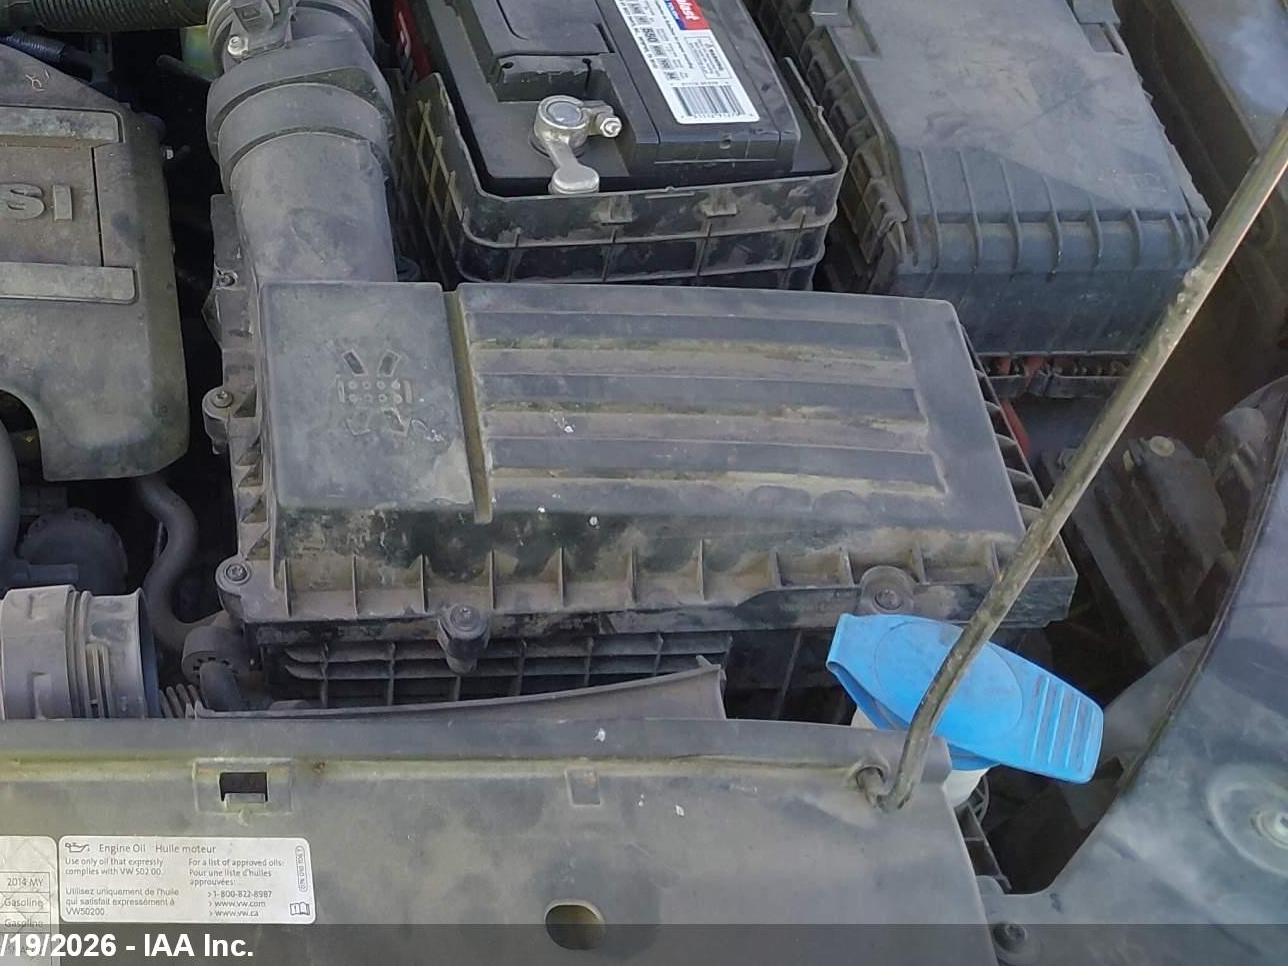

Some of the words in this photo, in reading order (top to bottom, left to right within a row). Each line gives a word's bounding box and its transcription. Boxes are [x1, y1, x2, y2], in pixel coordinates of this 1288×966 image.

[99, 843, 130, 855] Engine
[132, 843, 146, 853] Oil
[182, 845, 217, 853] moteur
[81, 858, 97, 867] only
[99, 857, 108, 865] oil
[111, 857, 126, 865] that
[128, 858, 163, 867] expressly
[188, 858, 201, 866] For
[208, 858, 220, 866] list
[222, 858, 230, 866] of
[232, 858, 267, 868] approved
[65, 868, 99, 877] complies
[189, 868, 207, 877] Pour
[224, 868, 240, 877] liste
[7, 877, 27, 886] 2014
[29, 878, 43, 886] MY
[96, 888, 142, 897] uniquement
[4, 898, 43, 907] Gasoline
[65, 898, 77, 906] qui
[80, 897, 110, 905] satisfait
[4, 919, 43, 928] Gasoline
